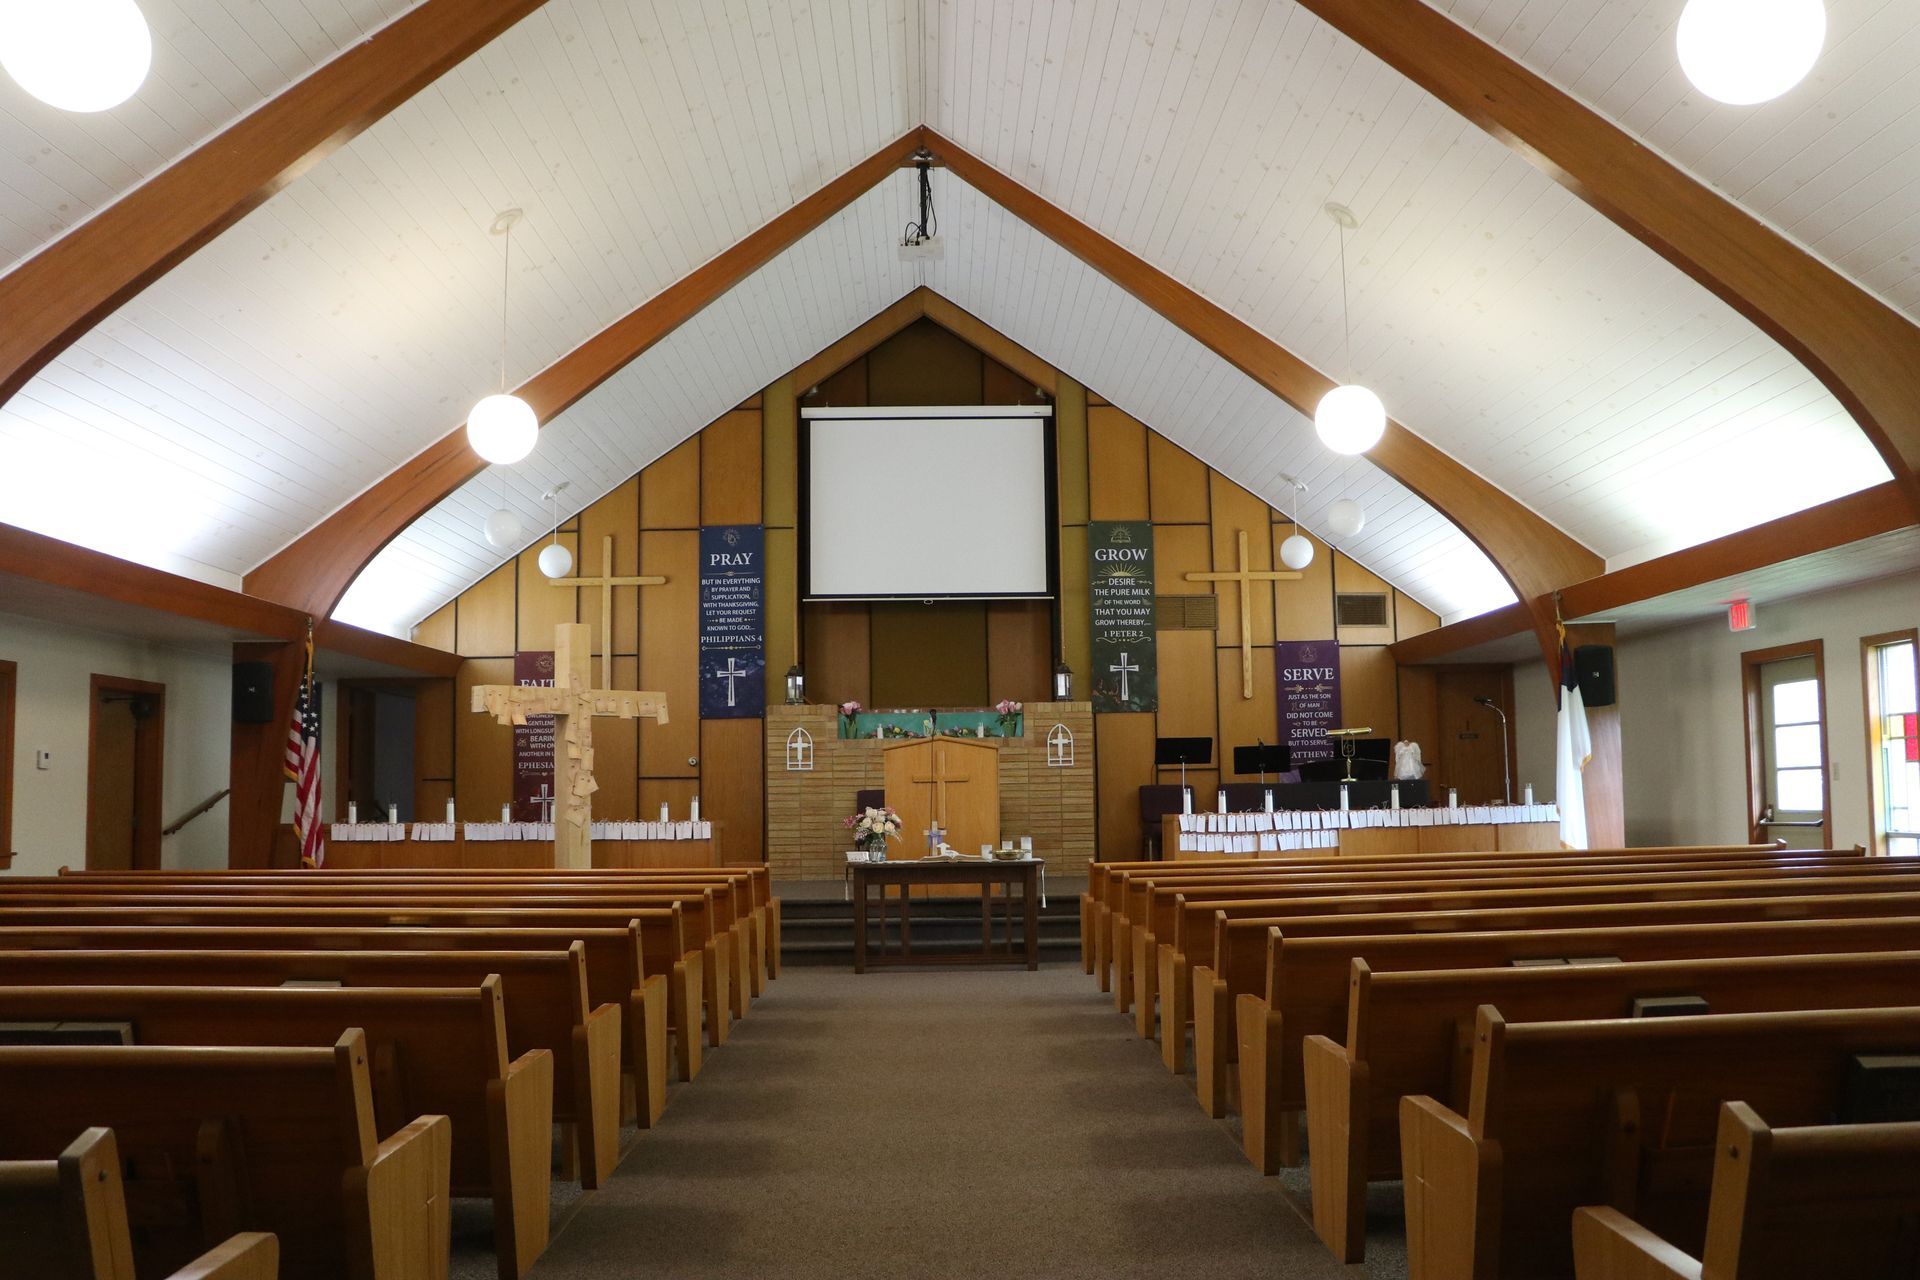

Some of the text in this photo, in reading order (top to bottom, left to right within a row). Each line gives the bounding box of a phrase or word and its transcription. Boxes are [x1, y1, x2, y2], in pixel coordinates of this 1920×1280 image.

[710, 552, 753, 566] PRAY
[1094, 548, 1148, 560] GROW
[1108, 578, 1136, 586] DESIRE
[1284, 668, 1334, 681] SERVE
[520, 679, 555, 688] FAIT
[1291, 750, 1328, 758] ATTHEW
